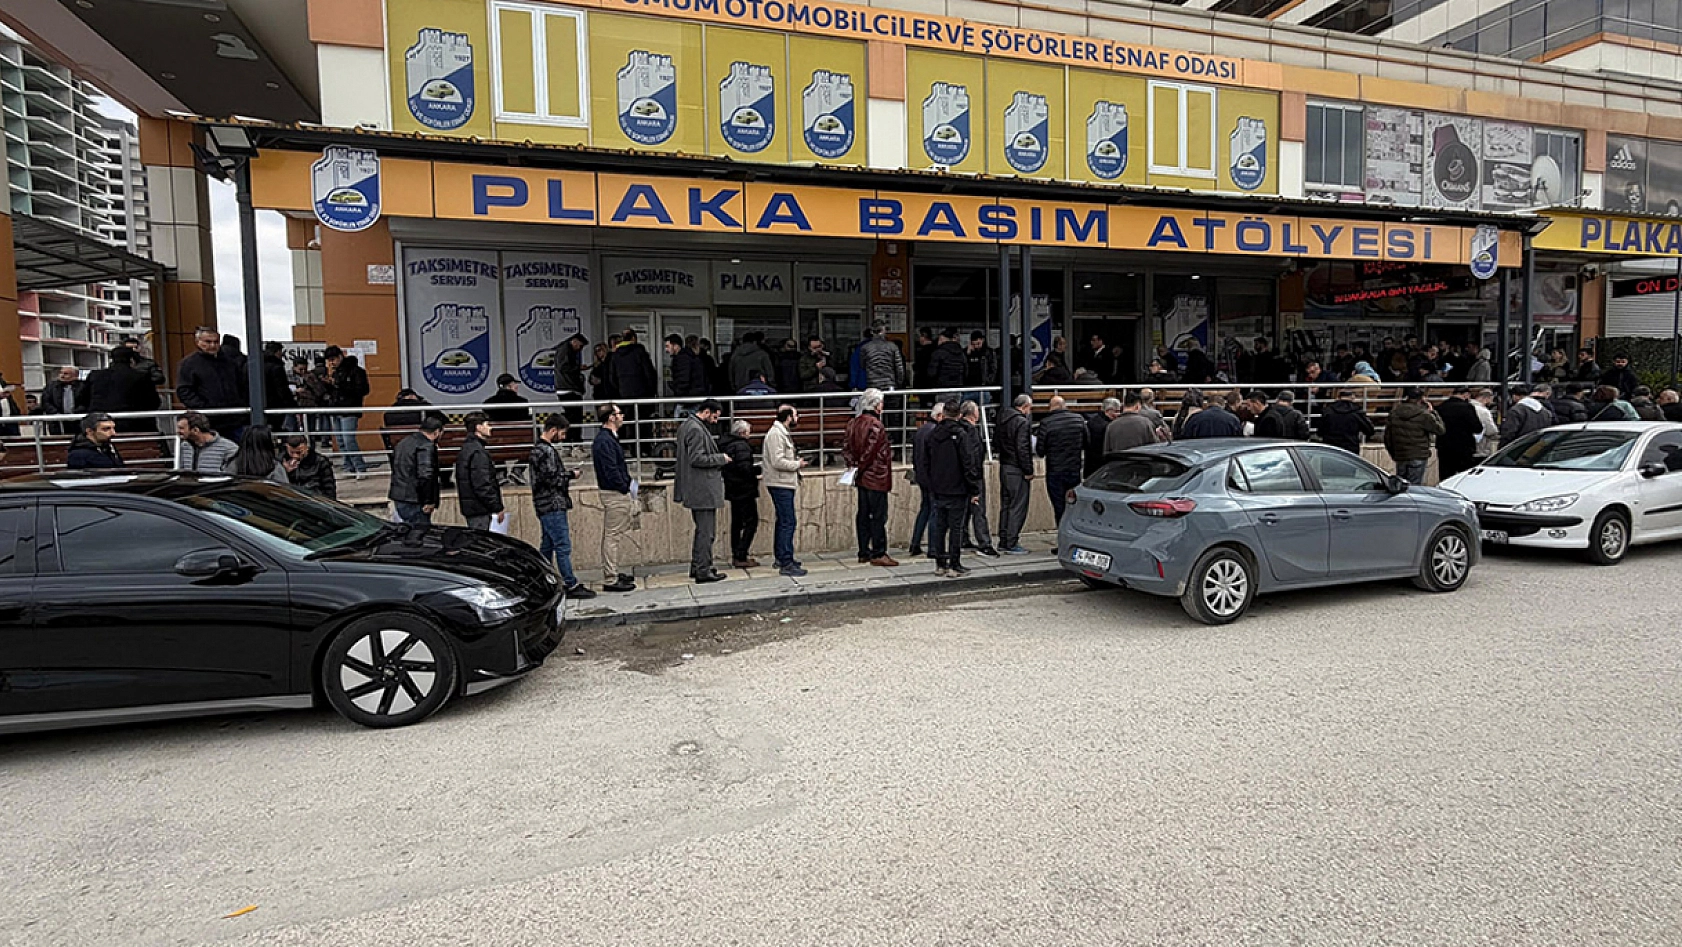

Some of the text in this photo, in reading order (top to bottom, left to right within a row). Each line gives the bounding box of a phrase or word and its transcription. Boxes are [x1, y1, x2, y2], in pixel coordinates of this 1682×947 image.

[945, 24, 975, 46] VE
[981, 29, 1099, 62] ŞÖFÖRLER
[1103, 44, 1170, 70] ESNAF
[1174, 54, 1236, 80] ODASI
[428, 103, 457, 112] ANKARA
[471, 173, 1433, 260] PLAKA BASIM ATÖLYESİ
[1581, 217, 1682, 254] PLAKA
[720, 273, 784, 291] PLAKA
[1636, 280, 1661, 294] ON
[442, 369, 472, 377] ANKARA
